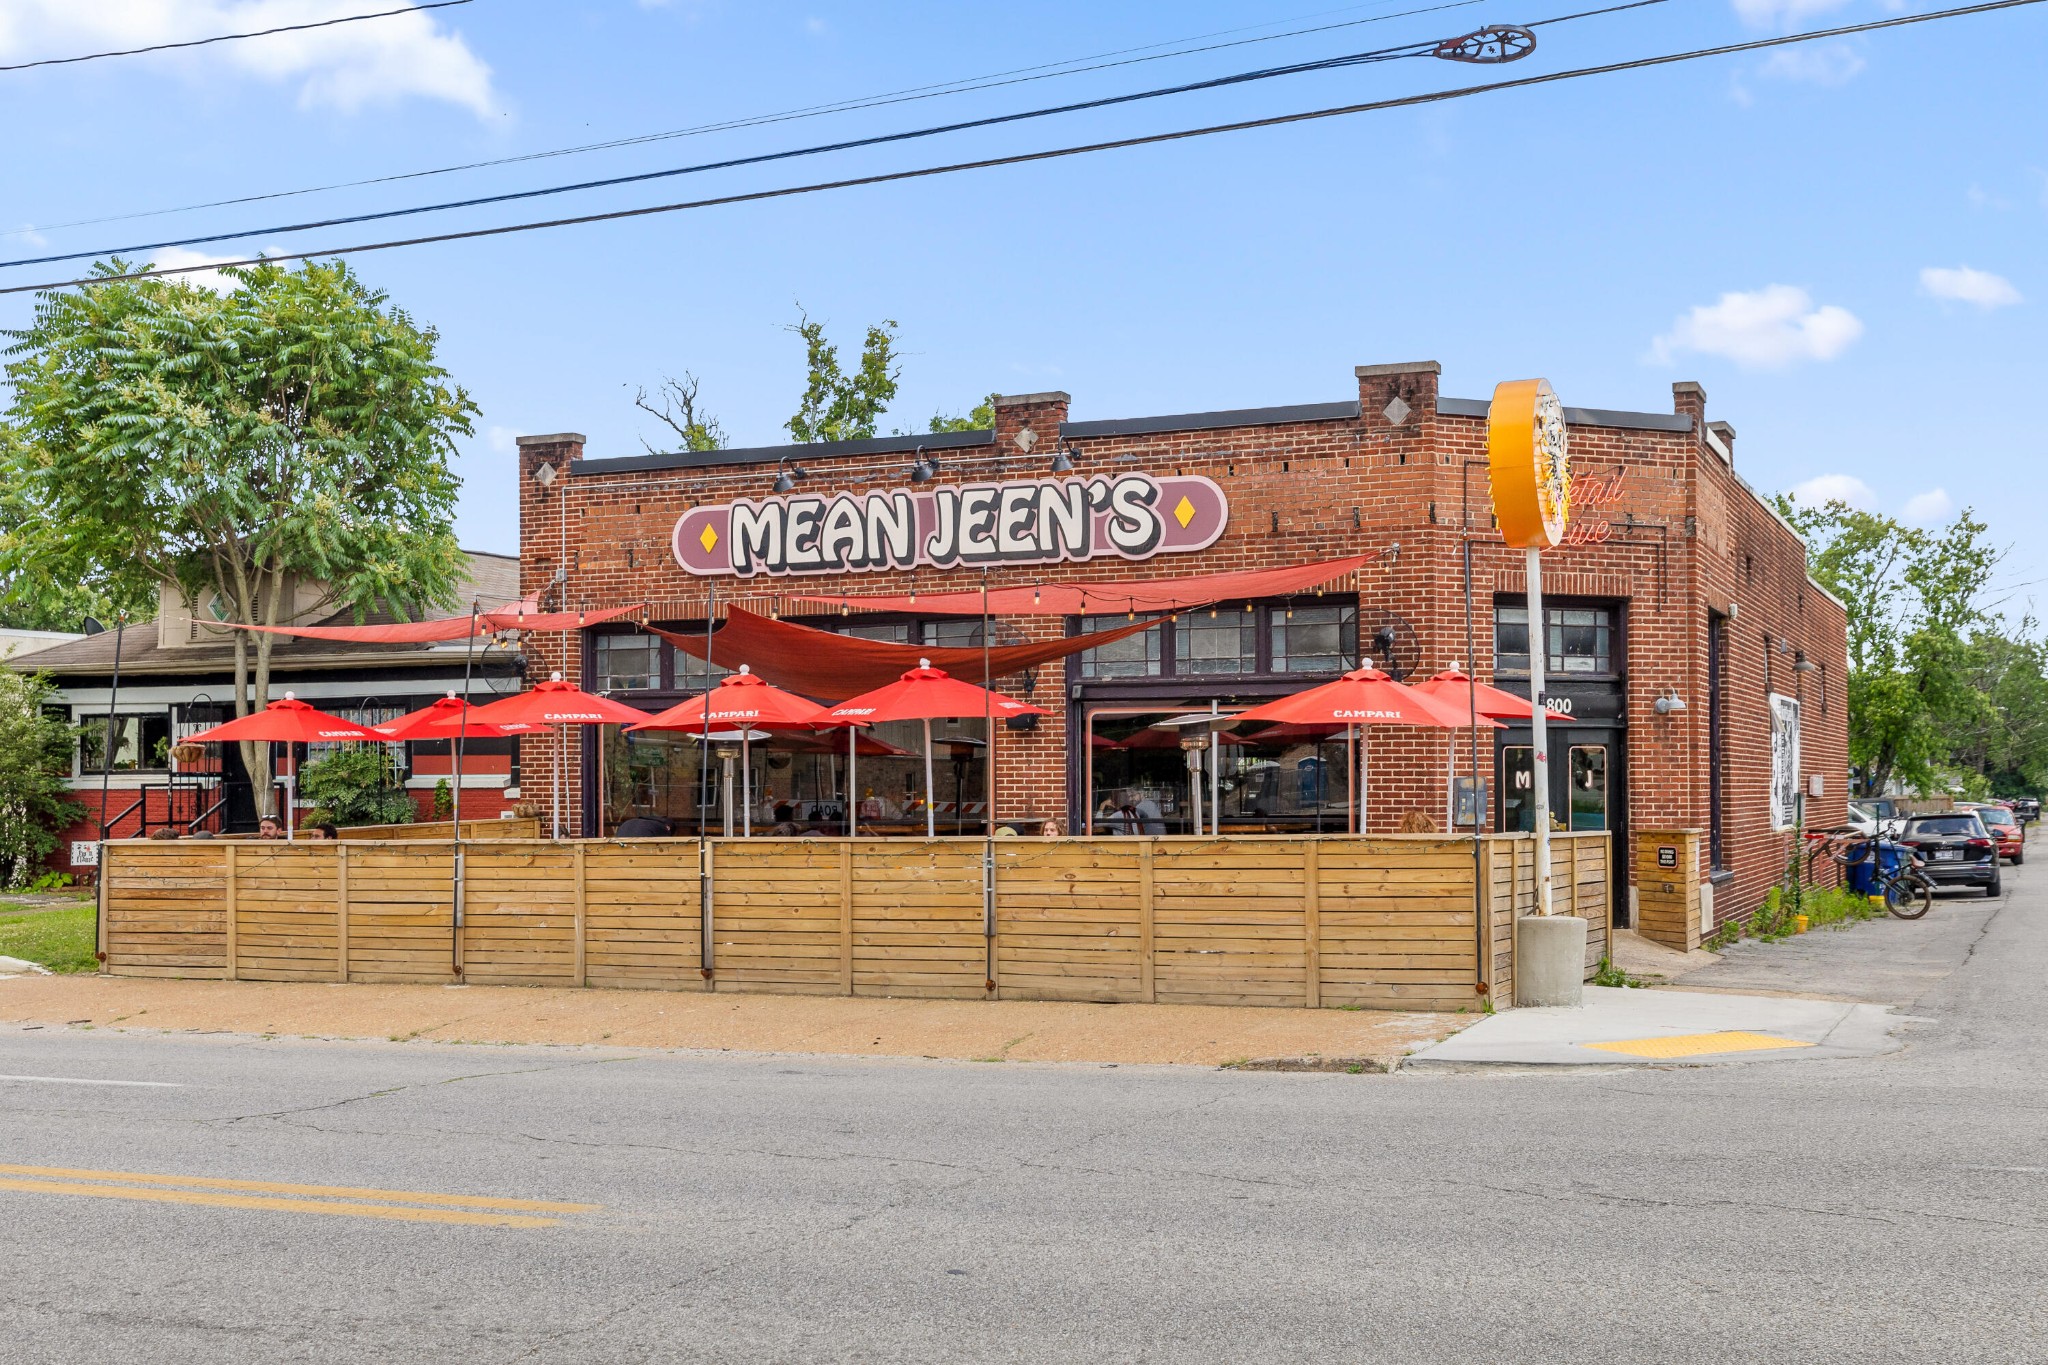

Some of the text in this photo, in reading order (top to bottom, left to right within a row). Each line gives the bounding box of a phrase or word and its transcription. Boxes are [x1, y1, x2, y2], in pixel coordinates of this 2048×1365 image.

[731, 478, 1161, 572] MEAN JEEN'S
[1333, 709, 1402, 719] CAMPARI
[1546, 697, 1572, 714] 800
[699, 709, 759, 720] CAMPARI
[1515, 769, 1594, 789] M J
